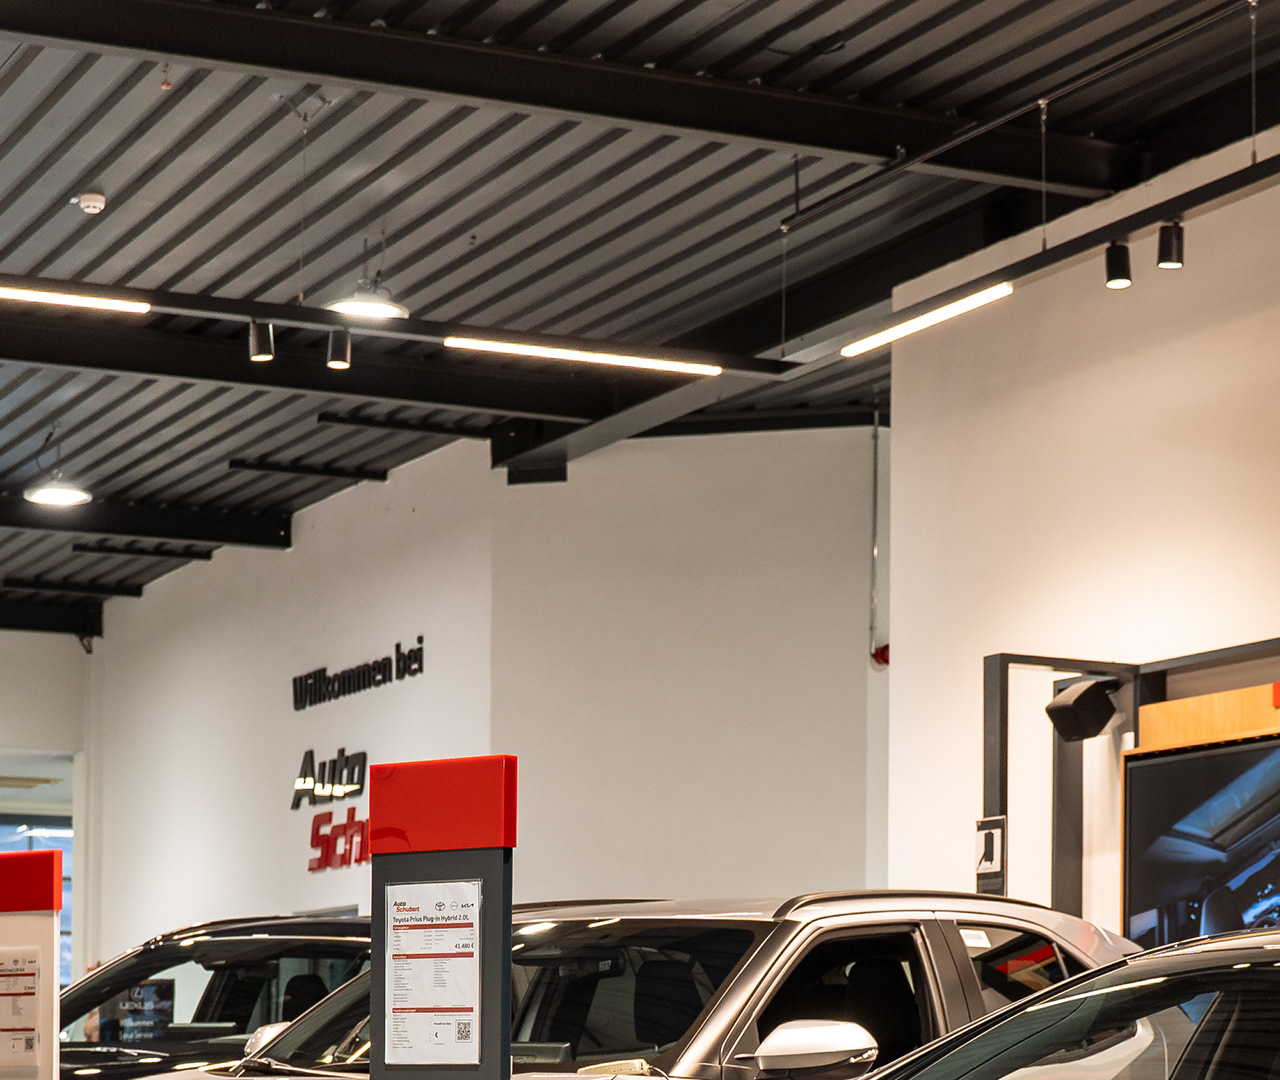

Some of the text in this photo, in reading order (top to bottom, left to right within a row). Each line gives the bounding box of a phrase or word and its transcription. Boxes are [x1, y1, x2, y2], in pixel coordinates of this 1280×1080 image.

[293, 635, 424, 711] Willkommen bei
[290, 747, 367, 810] Auto
[440, 914, 457, 922] Hybrid
[120, 1001, 154, 1010] LEXUS
